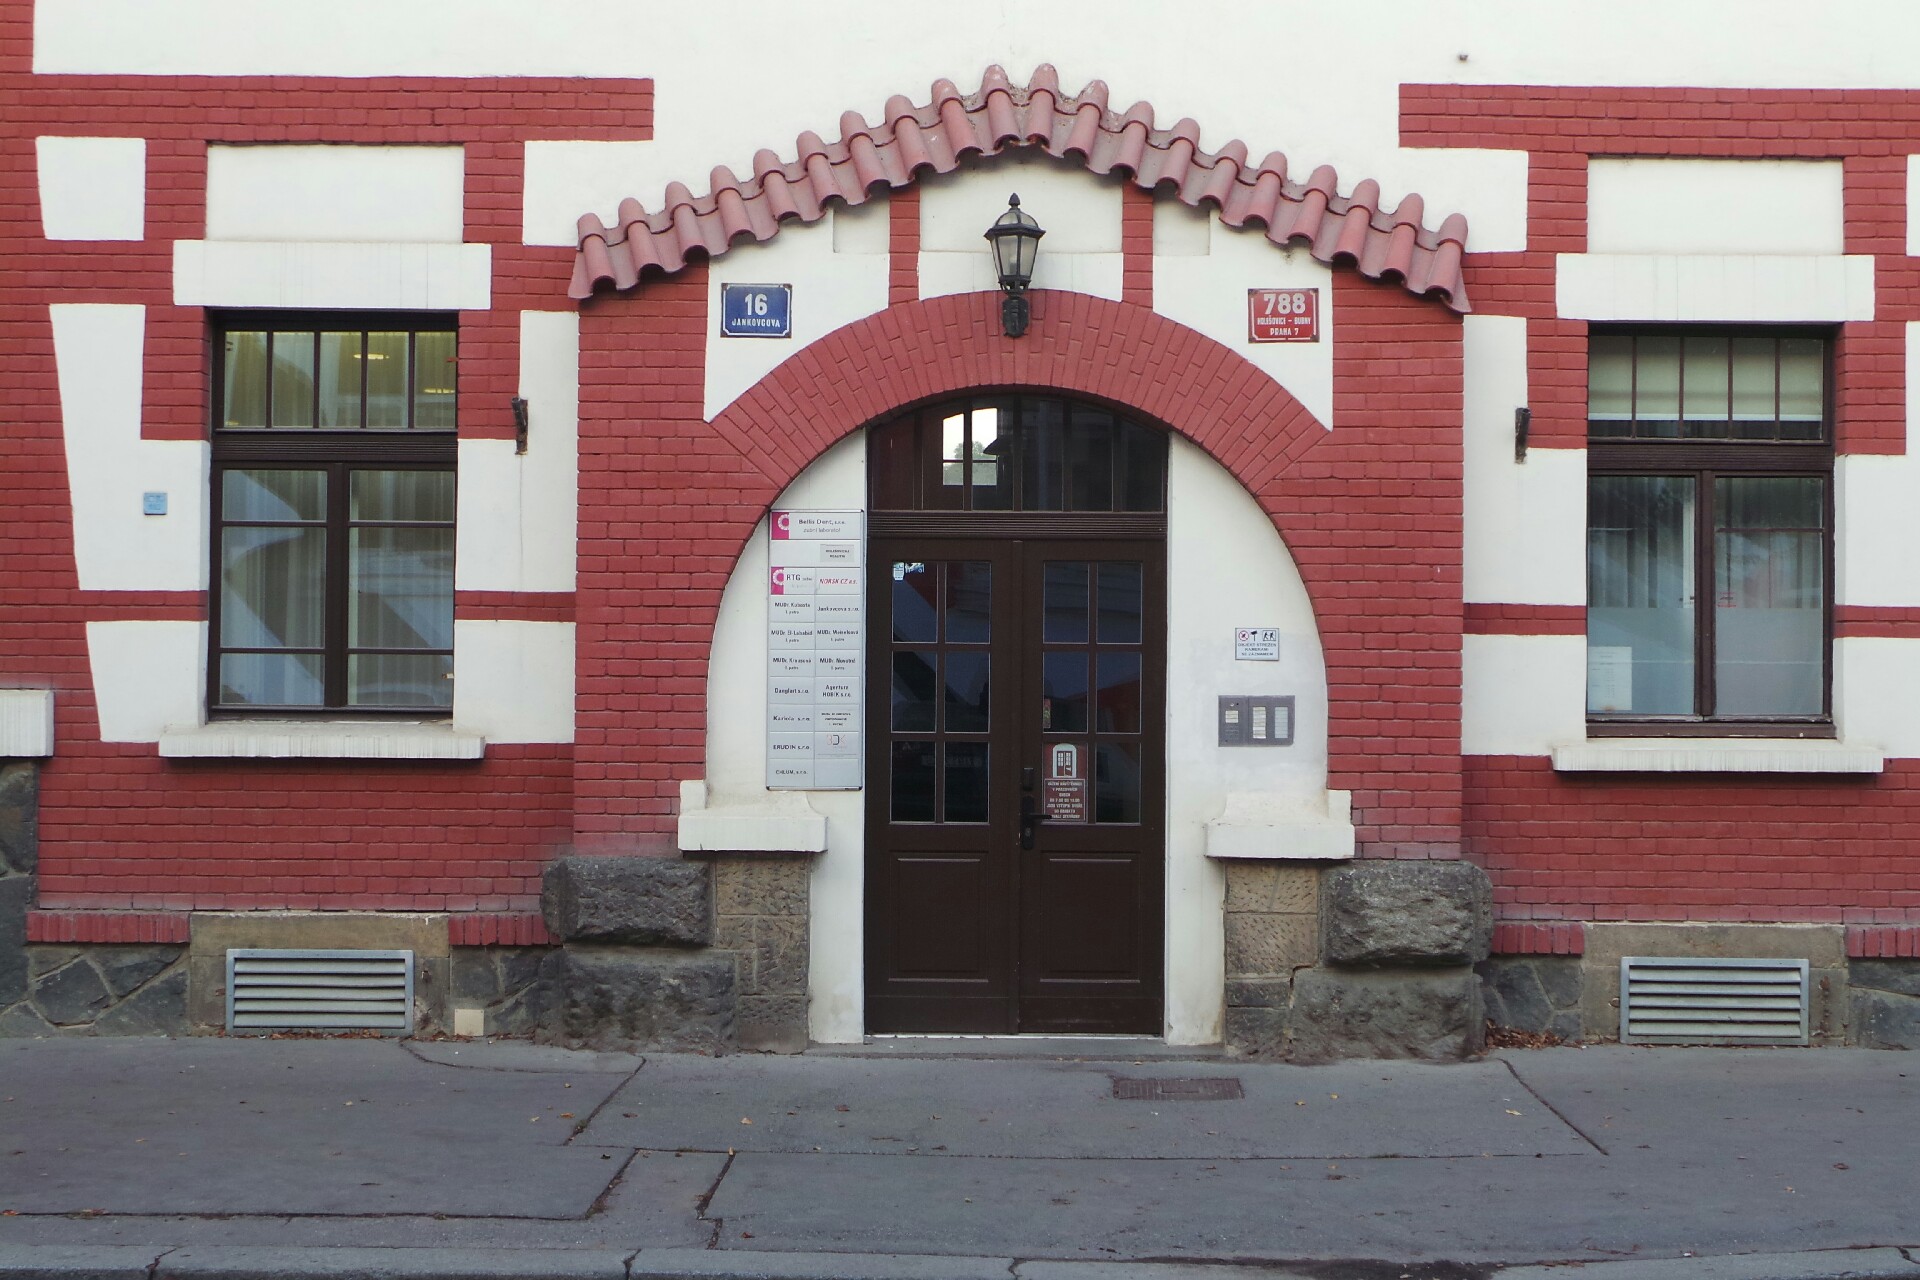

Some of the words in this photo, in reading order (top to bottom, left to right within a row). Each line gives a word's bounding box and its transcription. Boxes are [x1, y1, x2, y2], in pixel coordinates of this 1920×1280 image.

[745, 293, 768, 316] 16
[1263, 293, 1306, 315] 788
[731, 318, 781, 328] JANKOVCOVA
[1257, 315, 1286, 325] HOLEŠOVICE
[1294, 317, 1311, 325] BUBNY
[1270, 328, 1292, 336] PRAHA
[1294, 328, 1299, 336] 7
[786, 573, 801, 581] RTG
